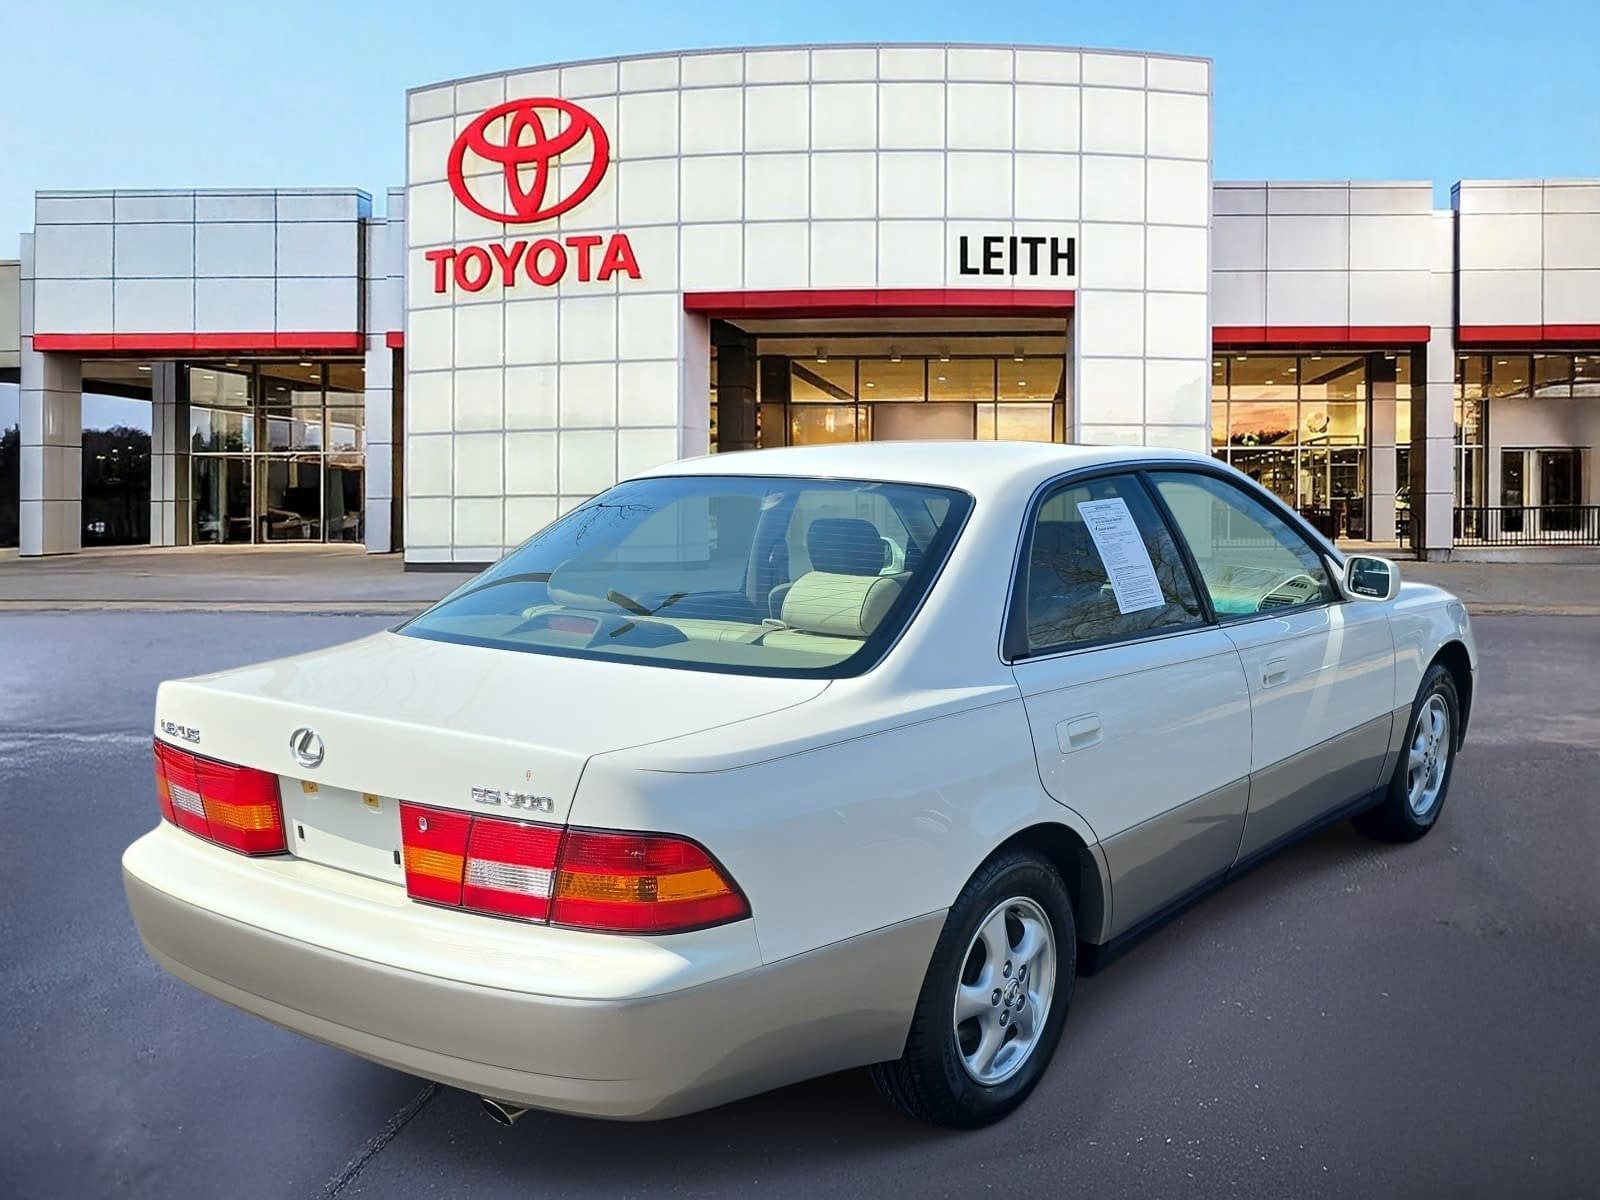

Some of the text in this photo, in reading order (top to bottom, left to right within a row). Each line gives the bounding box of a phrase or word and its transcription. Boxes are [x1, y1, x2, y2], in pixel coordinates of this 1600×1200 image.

[425, 234, 642, 293] TOYOTA
[959, 235, 1076, 276] LEITH
[471, 786, 555, 813] ES 300
